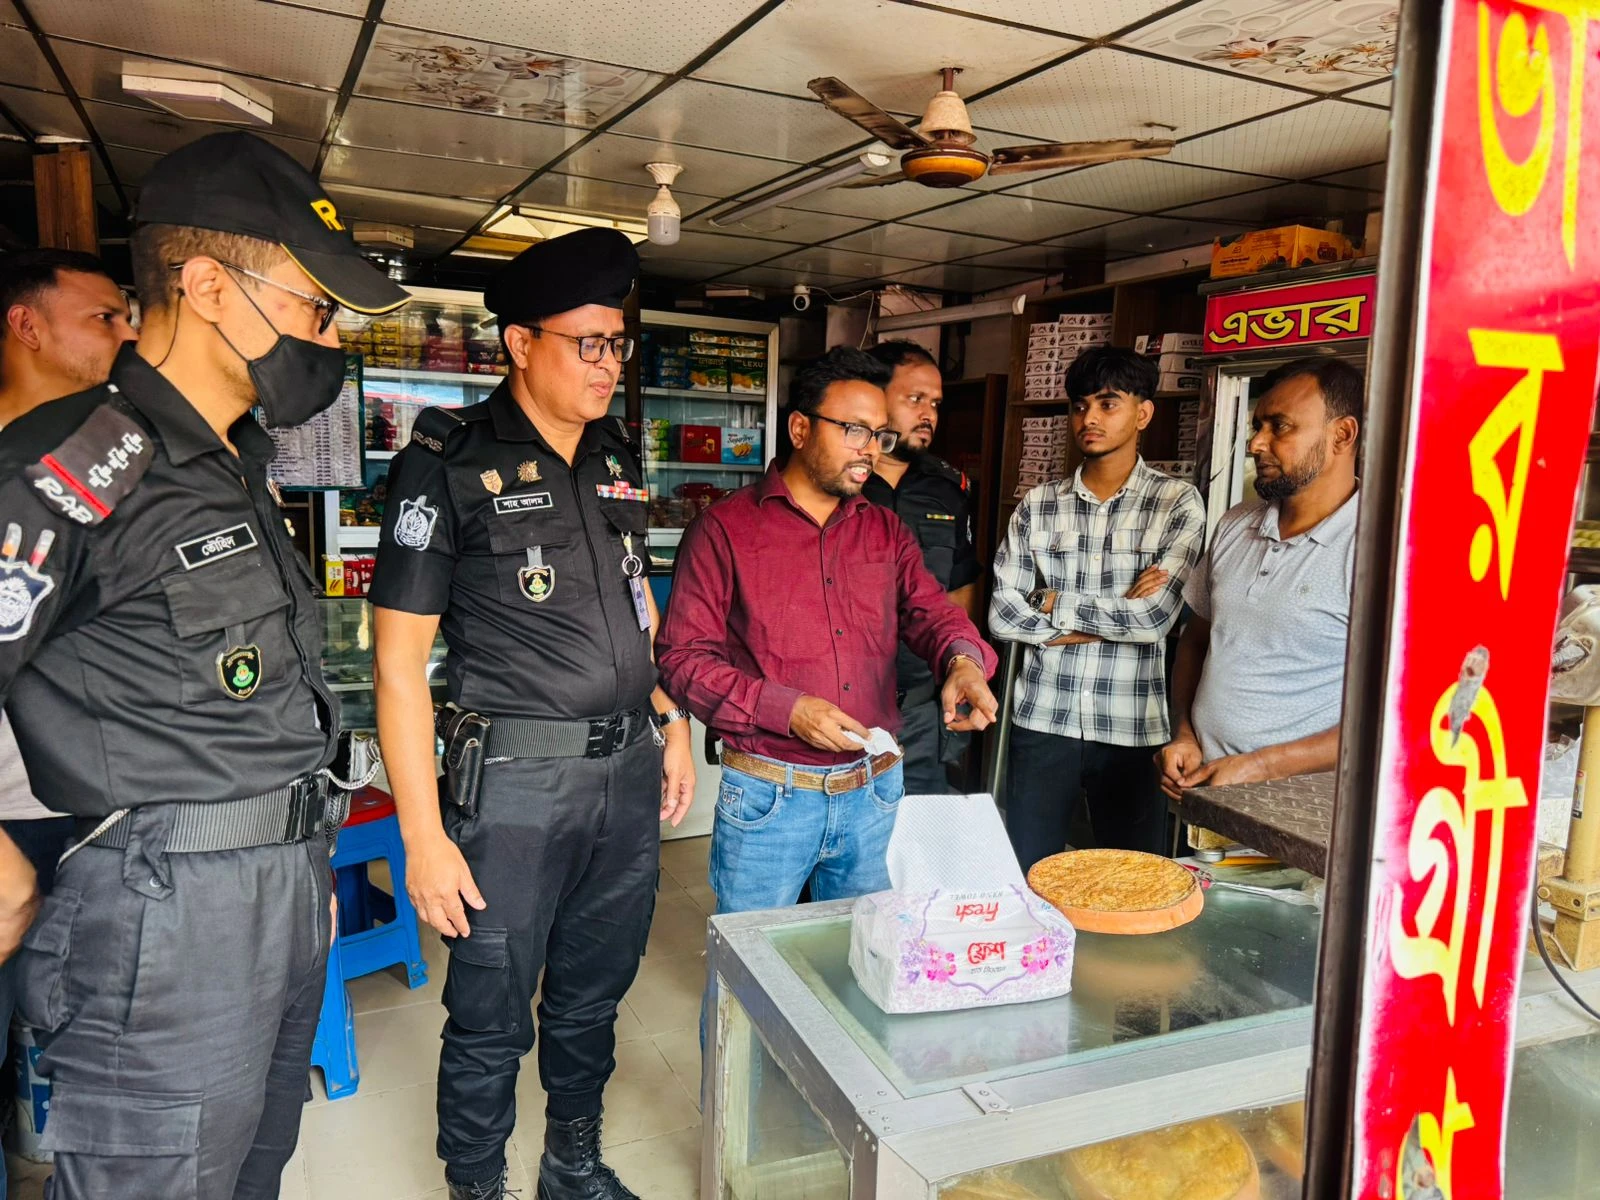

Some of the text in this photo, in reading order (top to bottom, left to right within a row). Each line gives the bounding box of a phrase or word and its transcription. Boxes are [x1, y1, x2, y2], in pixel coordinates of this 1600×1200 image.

[1208, 295, 1367, 344] এভার
[742, 360, 767, 368] LEXU
[33, 476, 94, 524] RAB
[502, 496, 544, 509] শাহ আলম
[201, 535, 236, 556] তৌহিদ
[967, 941, 1007, 965] ফ্রেশ
